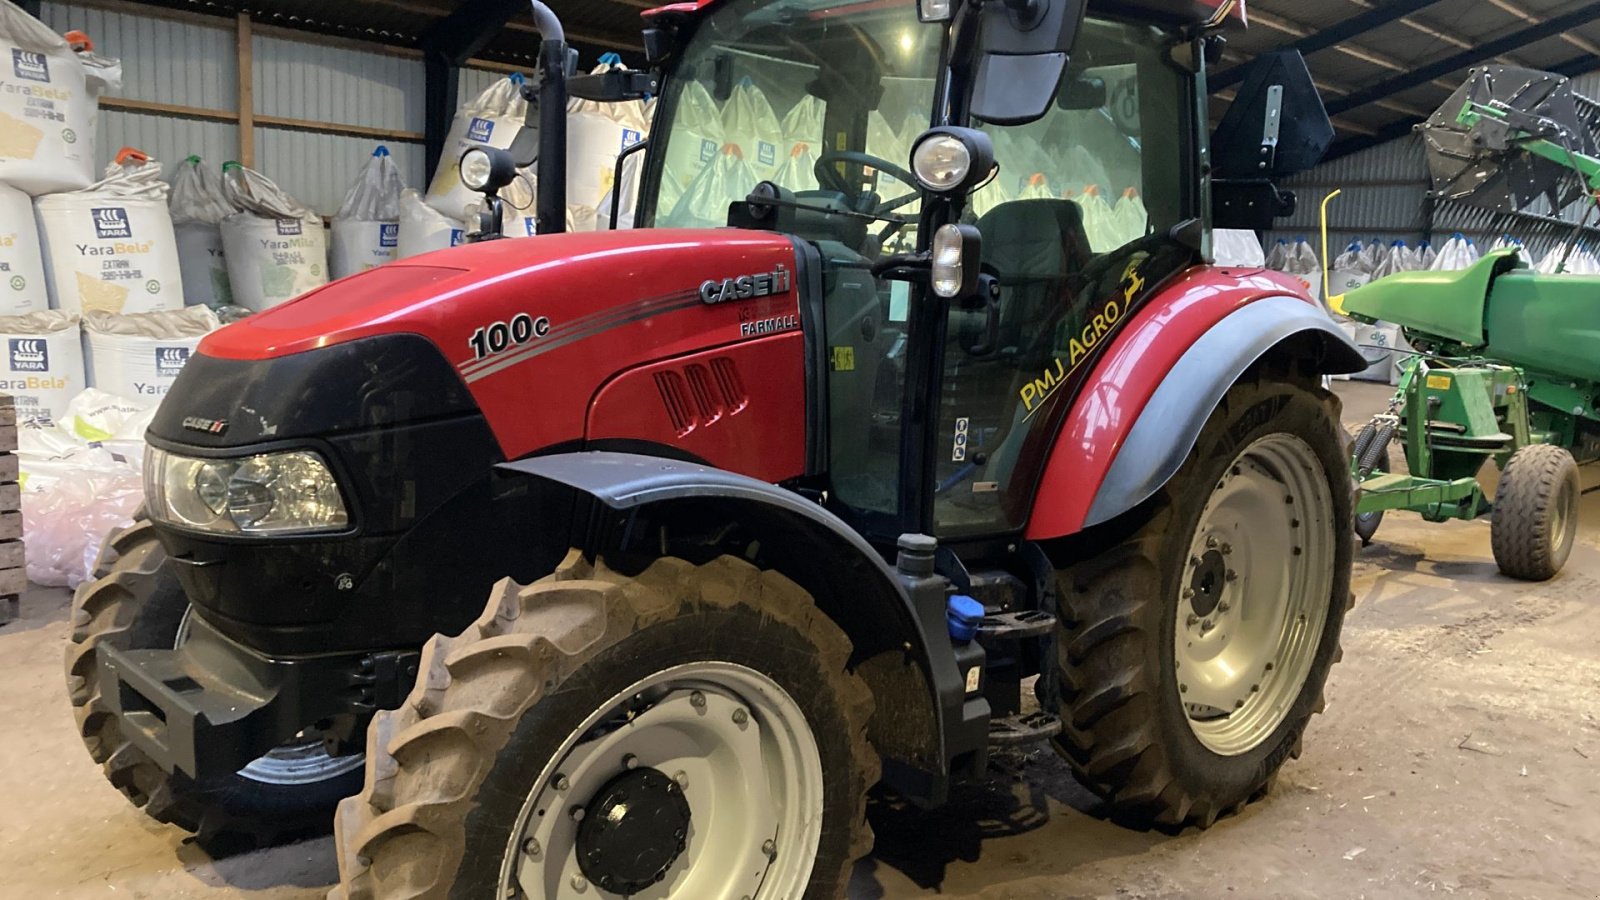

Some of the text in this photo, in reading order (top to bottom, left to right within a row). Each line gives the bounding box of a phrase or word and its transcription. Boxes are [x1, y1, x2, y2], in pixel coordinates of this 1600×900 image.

[100, 229, 128, 237] YARA
[76, 242, 149, 256] YaraBela
[740, 315, 798, 337] FARMALL
[1019, 300, 1119, 411] PMJ AGRO
[0, 376, 65, 390] araBela
